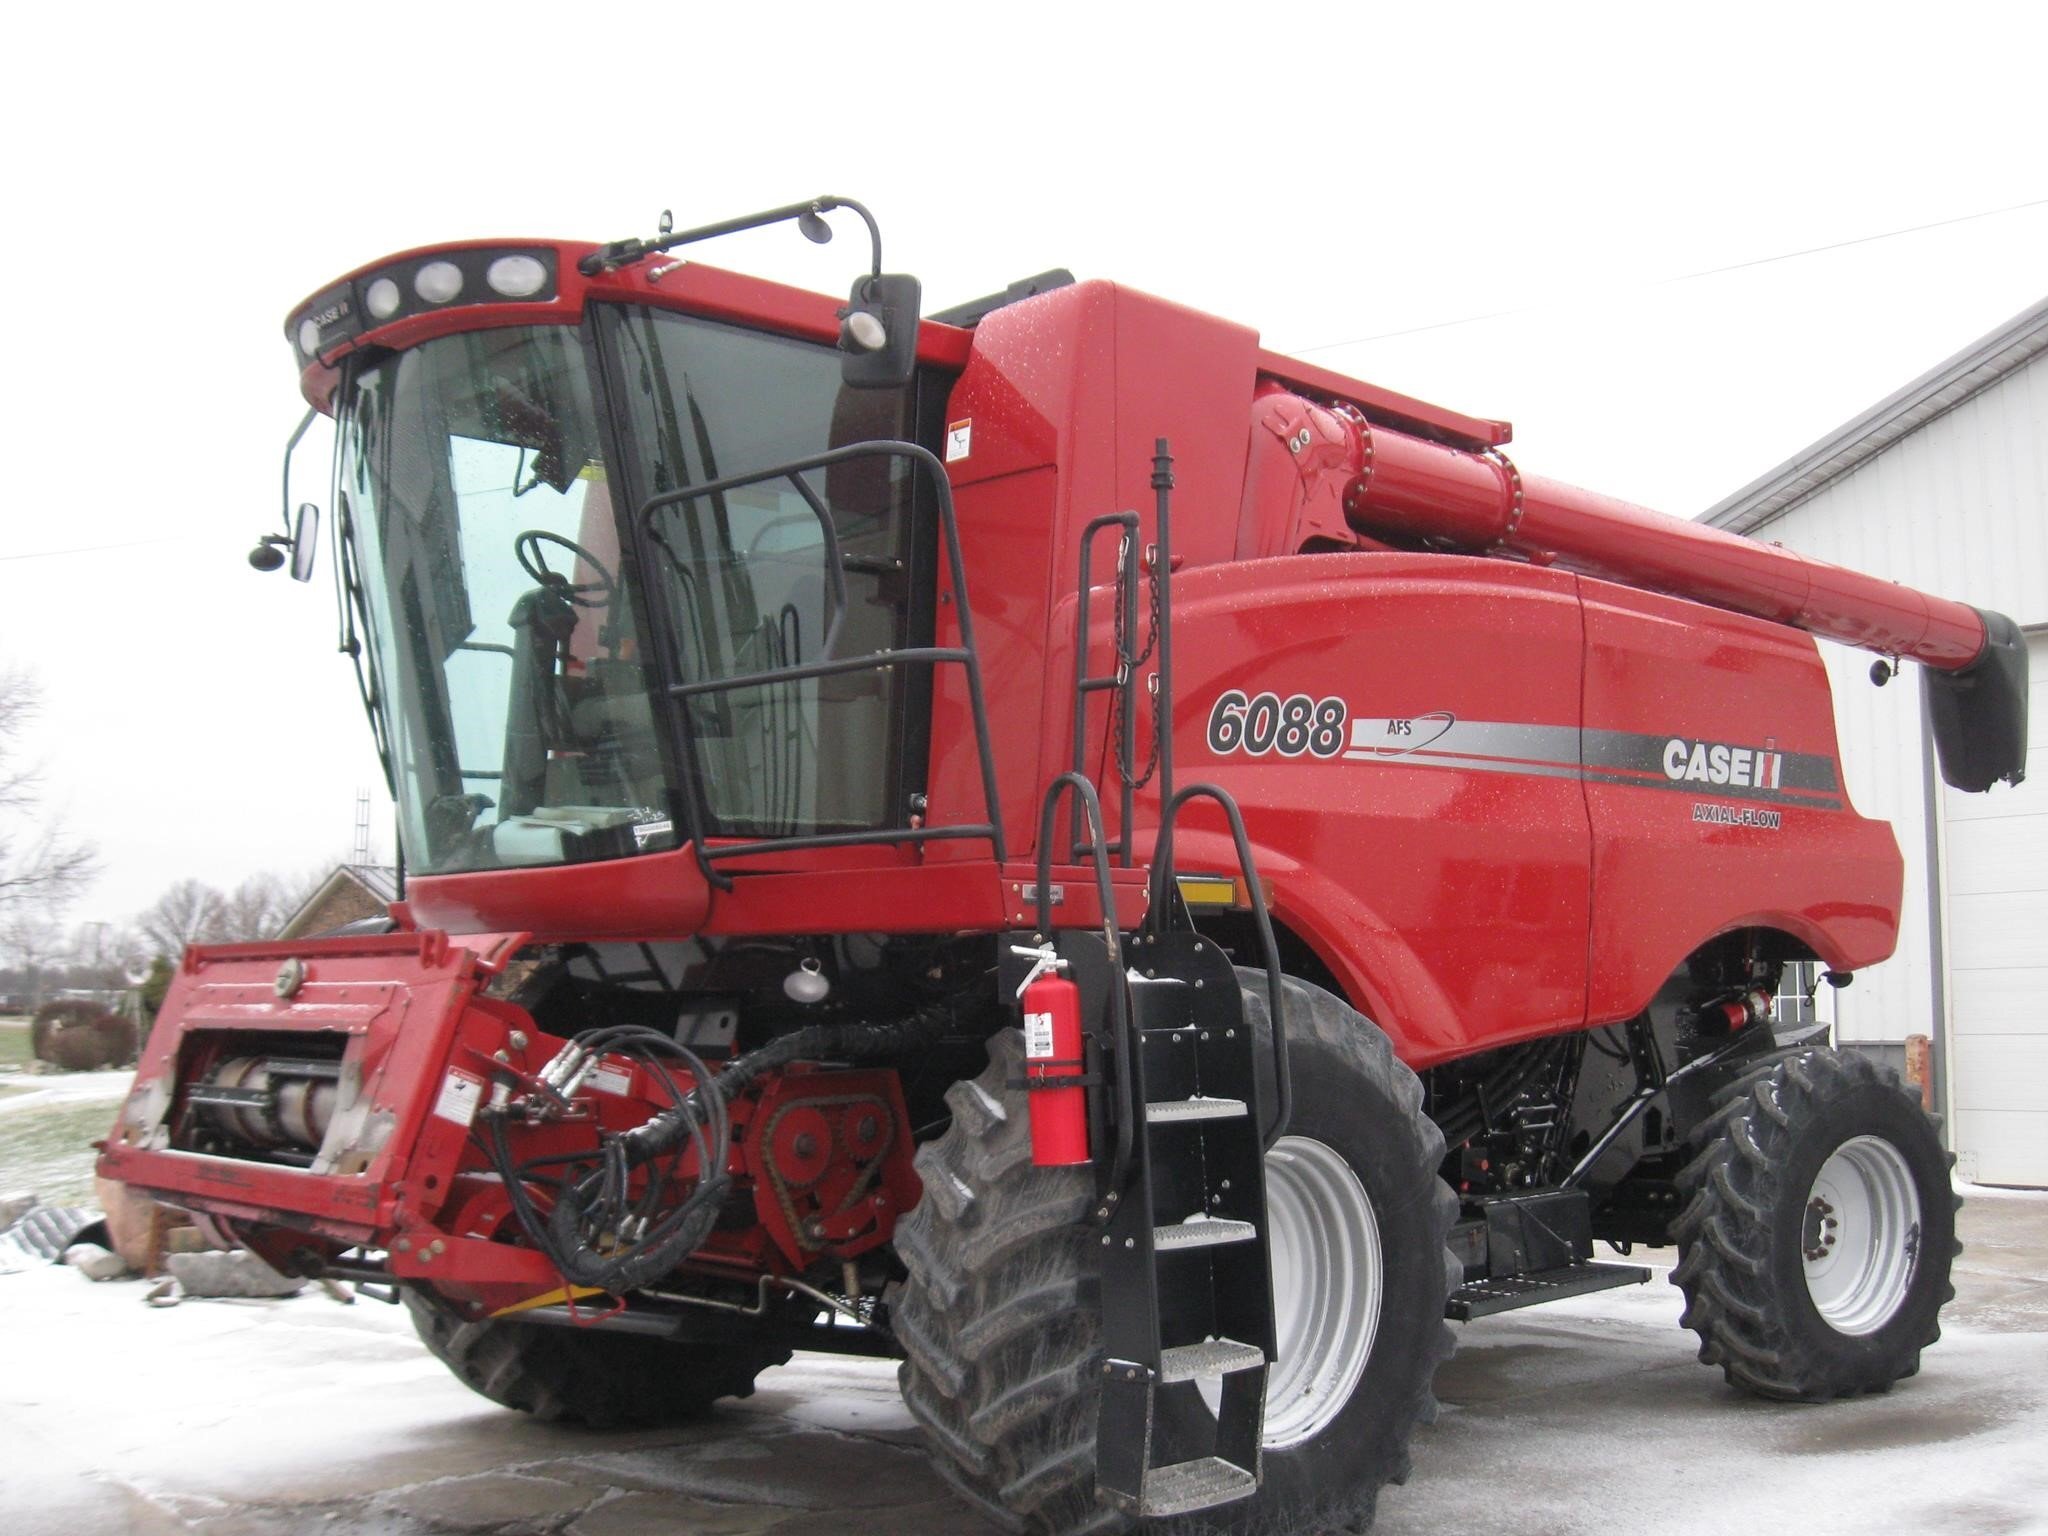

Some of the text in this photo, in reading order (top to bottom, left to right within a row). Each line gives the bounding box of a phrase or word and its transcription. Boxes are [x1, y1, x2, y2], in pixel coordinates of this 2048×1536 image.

[1207, 689, 1346, 759] 6088
[1387, 719, 1412, 736] AFS
[1662, 739, 1751, 787] CASE
[1693, 803, 1781, 829] AXIAL-FLOW
